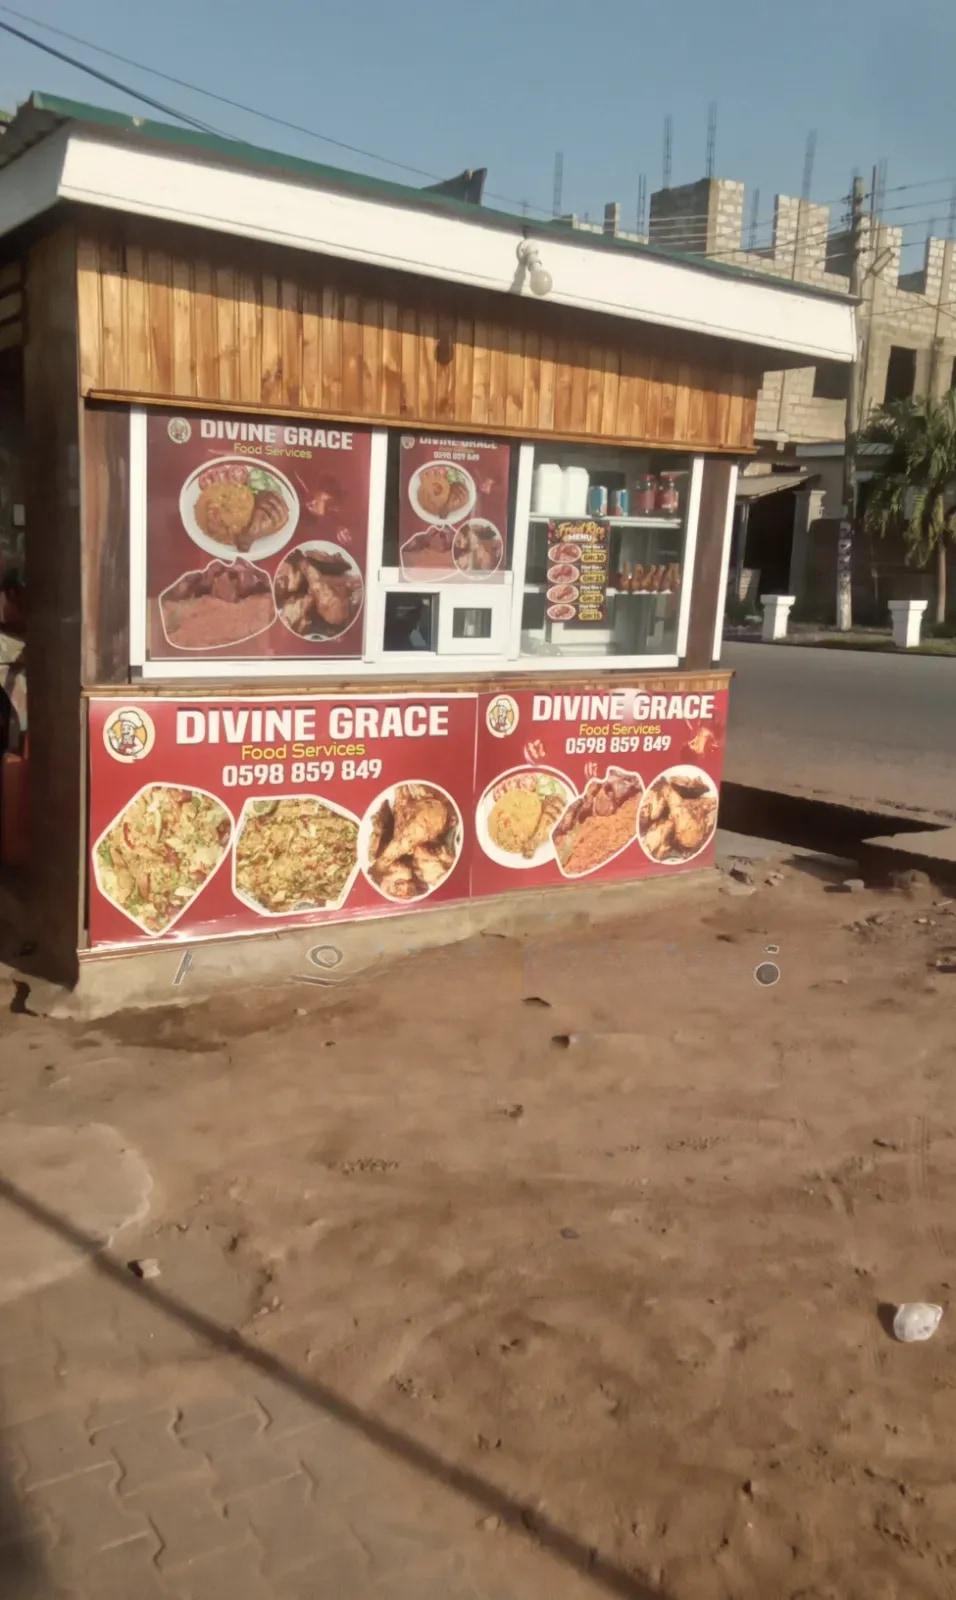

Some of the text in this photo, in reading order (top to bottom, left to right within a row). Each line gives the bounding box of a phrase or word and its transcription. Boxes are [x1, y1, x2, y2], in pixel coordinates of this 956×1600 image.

[200, 419, 353, 450] DIVINE GRACE
[233, 443, 312, 459] Food Services
[532, 694, 715, 721] DIVINE GRACE
[176, 705, 448, 744] DIVINE GRACE
[579, 722, 662, 736] Food Services
[241, 741, 366, 761] Food Services
[565, 735, 672, 755] 0598 859 849
[222, 759, 383, 787] 0598 859 849
